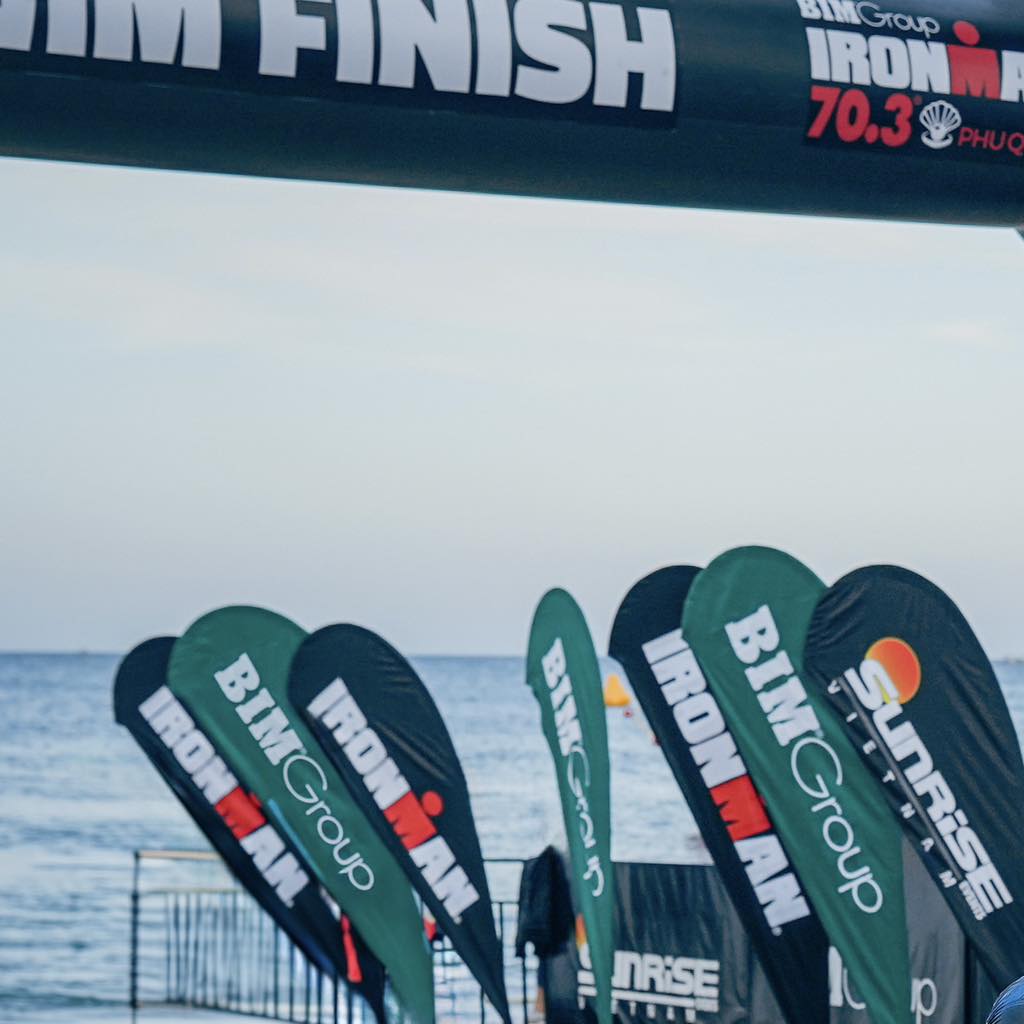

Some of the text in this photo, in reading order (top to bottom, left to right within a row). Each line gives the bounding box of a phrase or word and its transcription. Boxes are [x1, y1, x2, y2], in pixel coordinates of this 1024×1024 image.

[258, 0, 676, 113] FINISH
[807, 85, 914, 148] 70.3
[138, 685, 310, 908] IRONMAN
[306, 676, 480, 923] IRONMAN
[641, 627, 811, 932] IRONMAN
